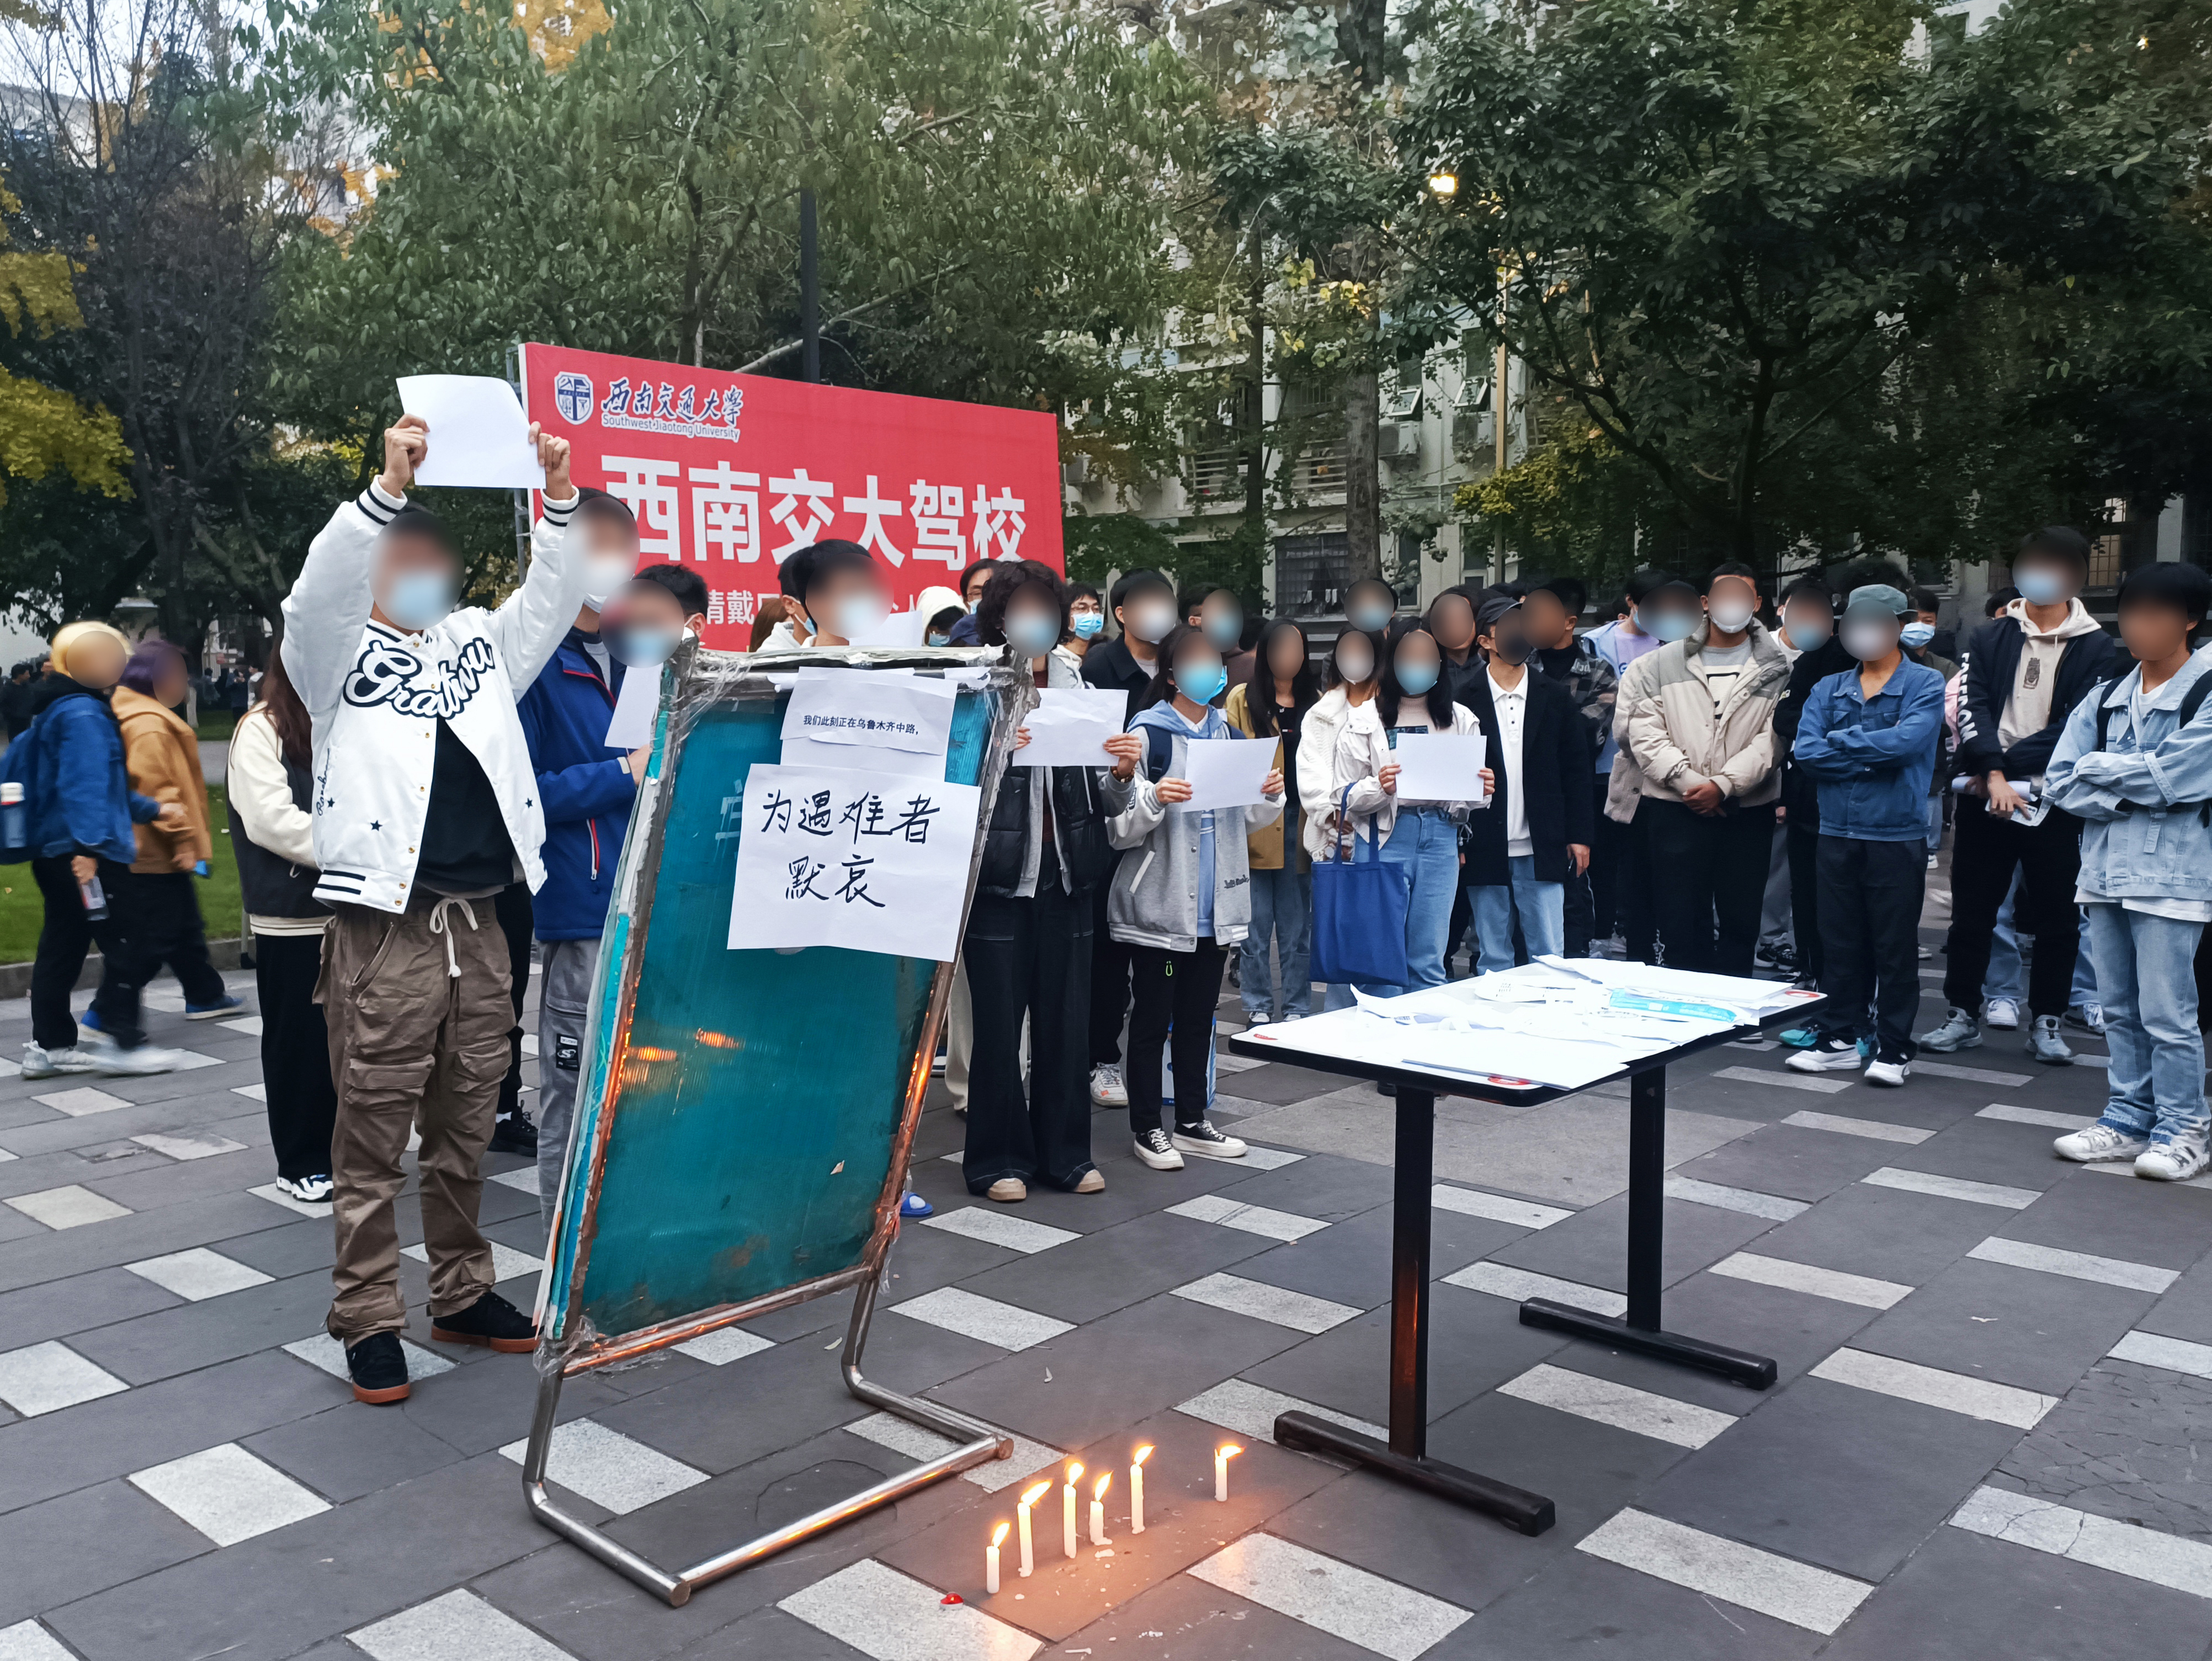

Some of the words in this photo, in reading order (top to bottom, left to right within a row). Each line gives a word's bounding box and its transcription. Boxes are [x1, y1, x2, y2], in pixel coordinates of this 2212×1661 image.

[603, 414, 652, 429] Southwest
[655, 420, 693, 435] Jiaotong
[696, 425, 738, 440] University
[601, 455, 1026, 571] 西南交大驾校
[761, 789, 940, 844] 为遇难者
[785, 854, 885, 908] 默哀
